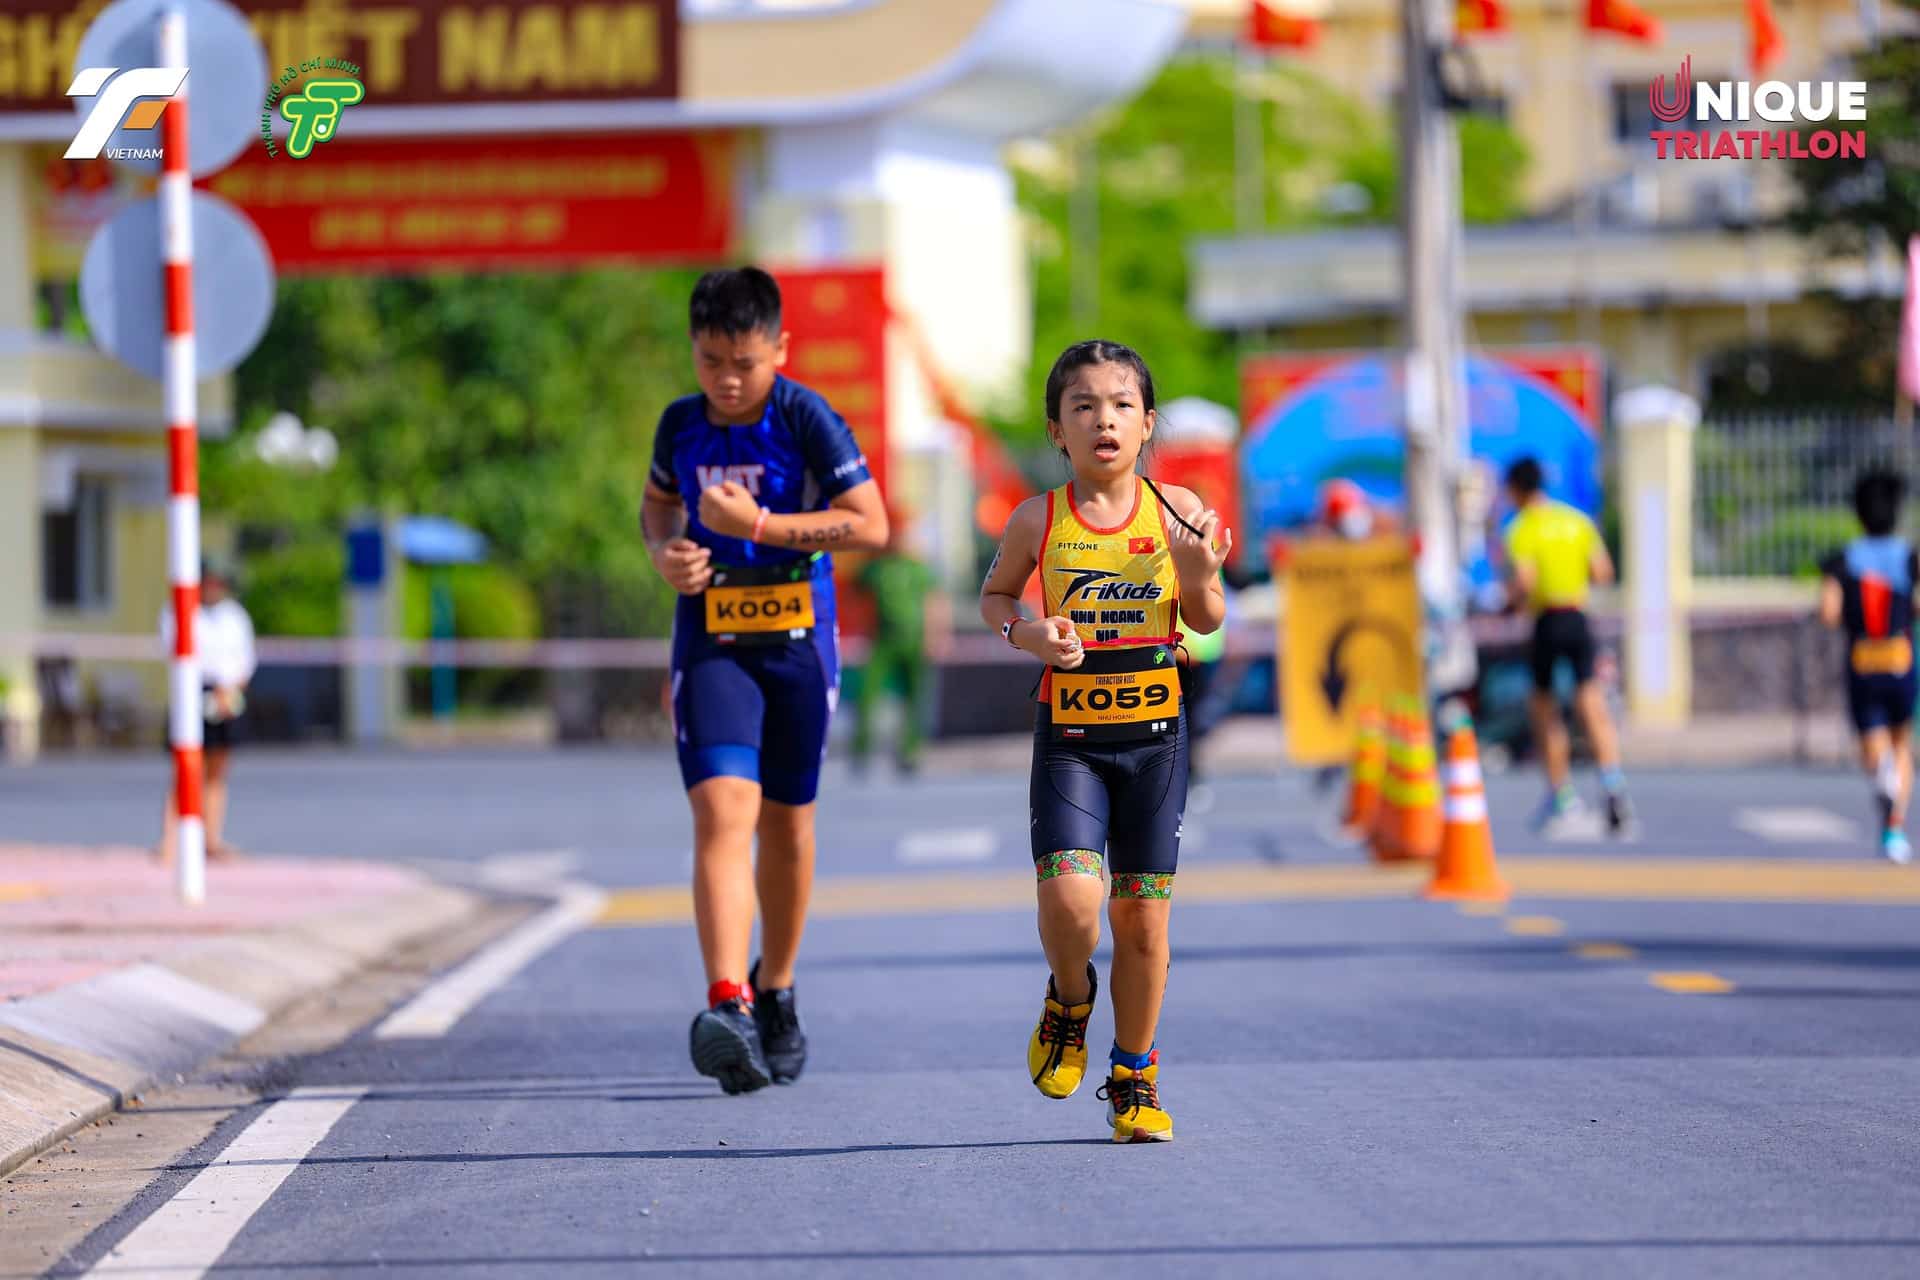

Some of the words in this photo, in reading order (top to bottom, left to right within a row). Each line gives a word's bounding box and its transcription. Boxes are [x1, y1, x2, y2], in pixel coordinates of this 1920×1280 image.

[439, 5, 660, 92] NAM
[1058, 542, 1098, 551] FITZONE
[1053, 568, 1163, 609] TriKids
[717, 597, 802, 620] K004
[1061, 684, 1170, 711] K059
